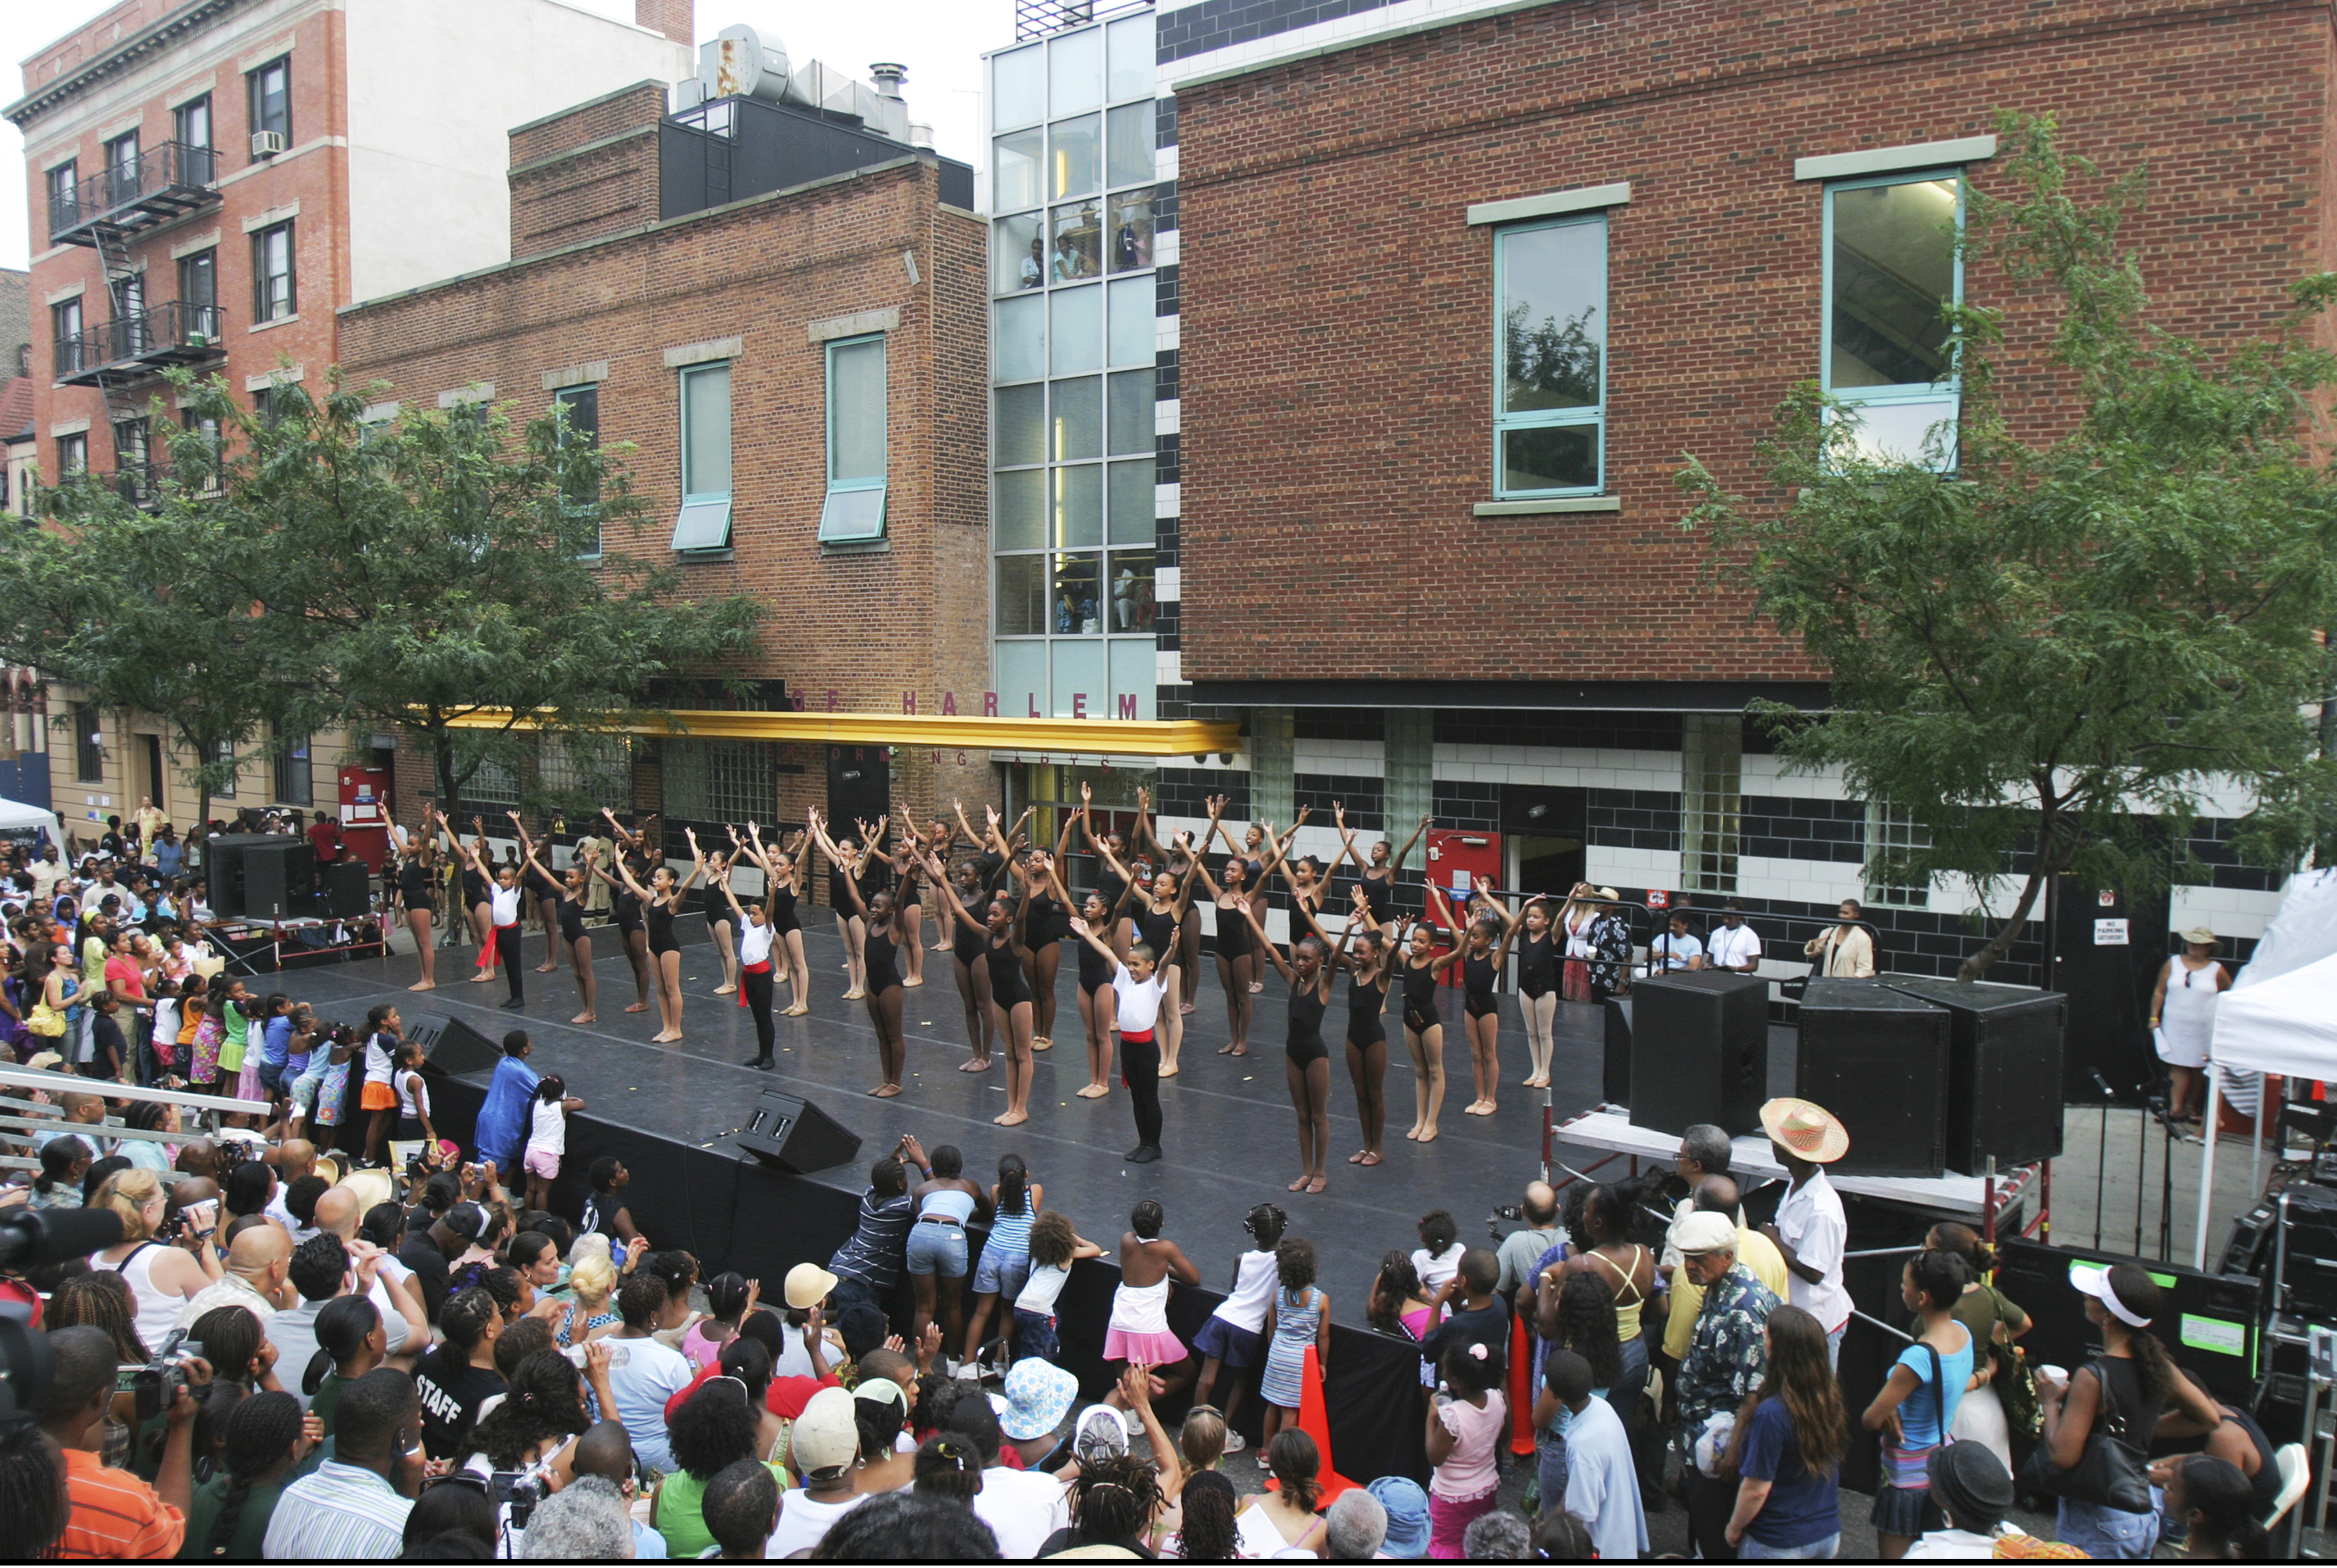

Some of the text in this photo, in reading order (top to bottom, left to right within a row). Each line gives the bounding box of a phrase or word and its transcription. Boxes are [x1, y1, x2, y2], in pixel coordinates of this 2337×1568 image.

[791, 688, 1137, 720] OF HARLEM
[666, 741, 1111, 773] FOR PERFORMING ARTS
[416, 1374, 462, 1425] STAFF
